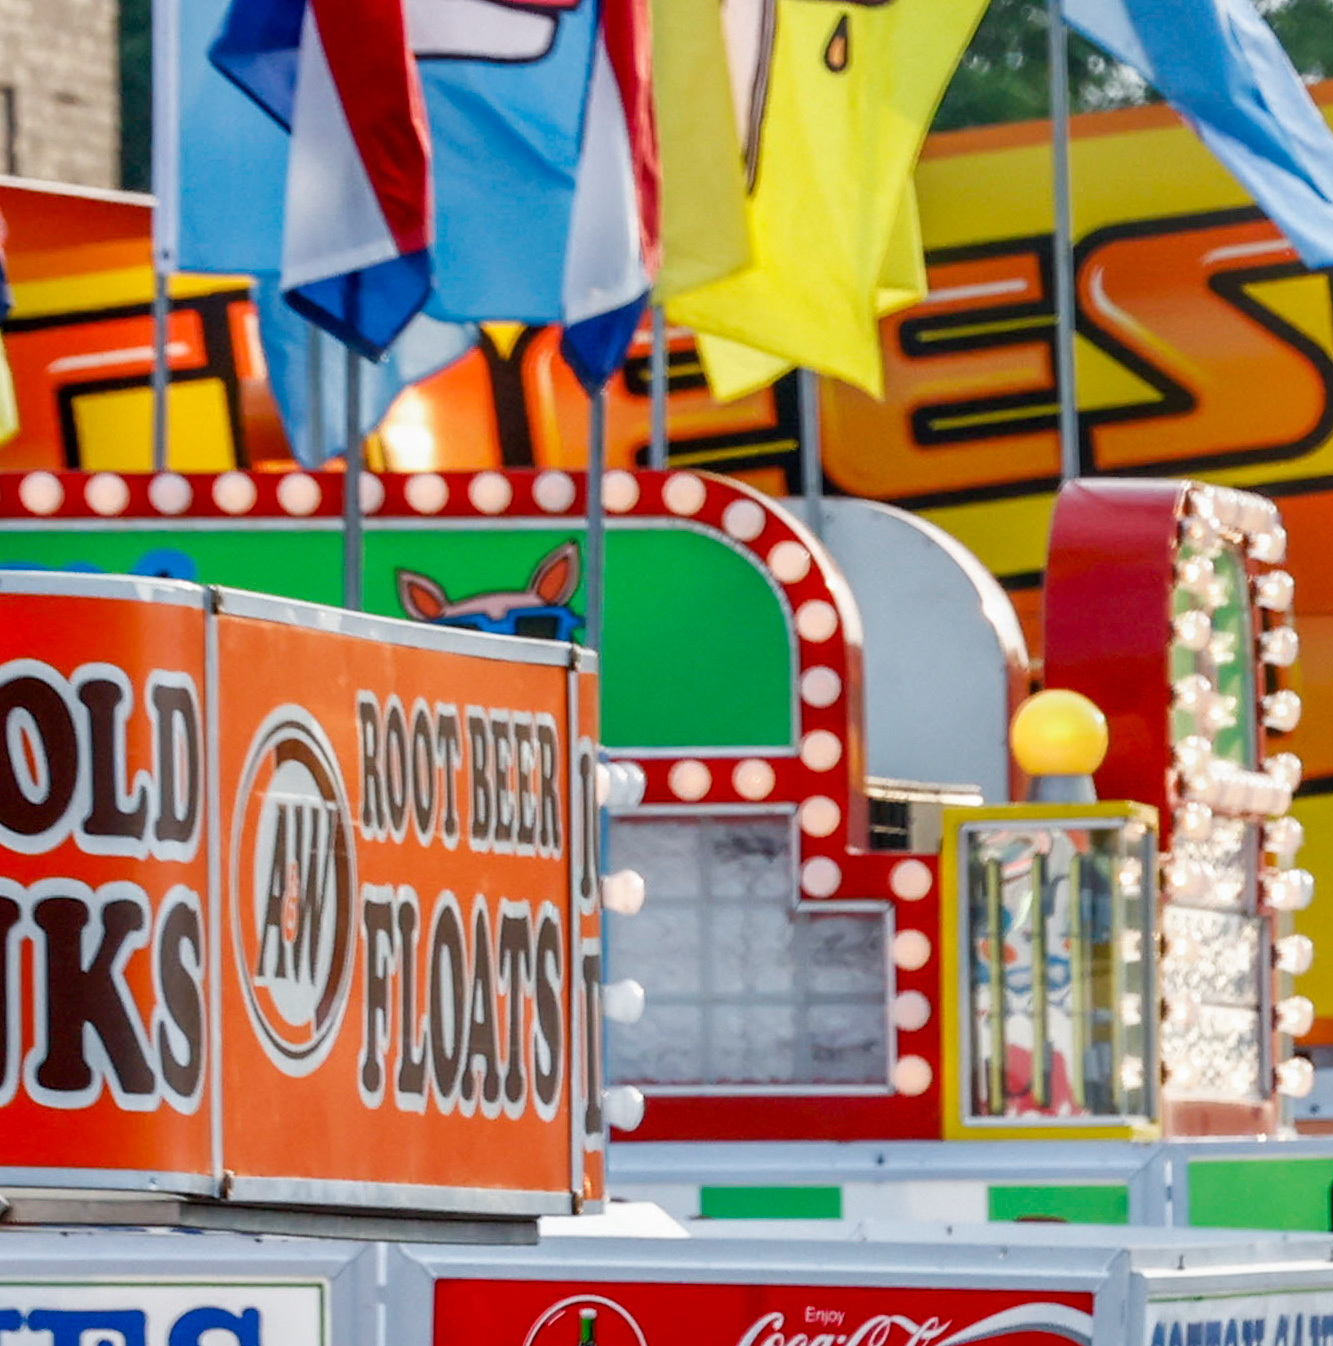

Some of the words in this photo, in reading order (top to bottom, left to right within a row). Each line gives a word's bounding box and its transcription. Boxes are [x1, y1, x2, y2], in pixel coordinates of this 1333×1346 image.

[356, 690, 463, 854] ROOT
[466, 705, 563, 860] BEER
[357, 884, 564, 1122] FLOATS
[803, 1305, 846, 1327] Enjoy
